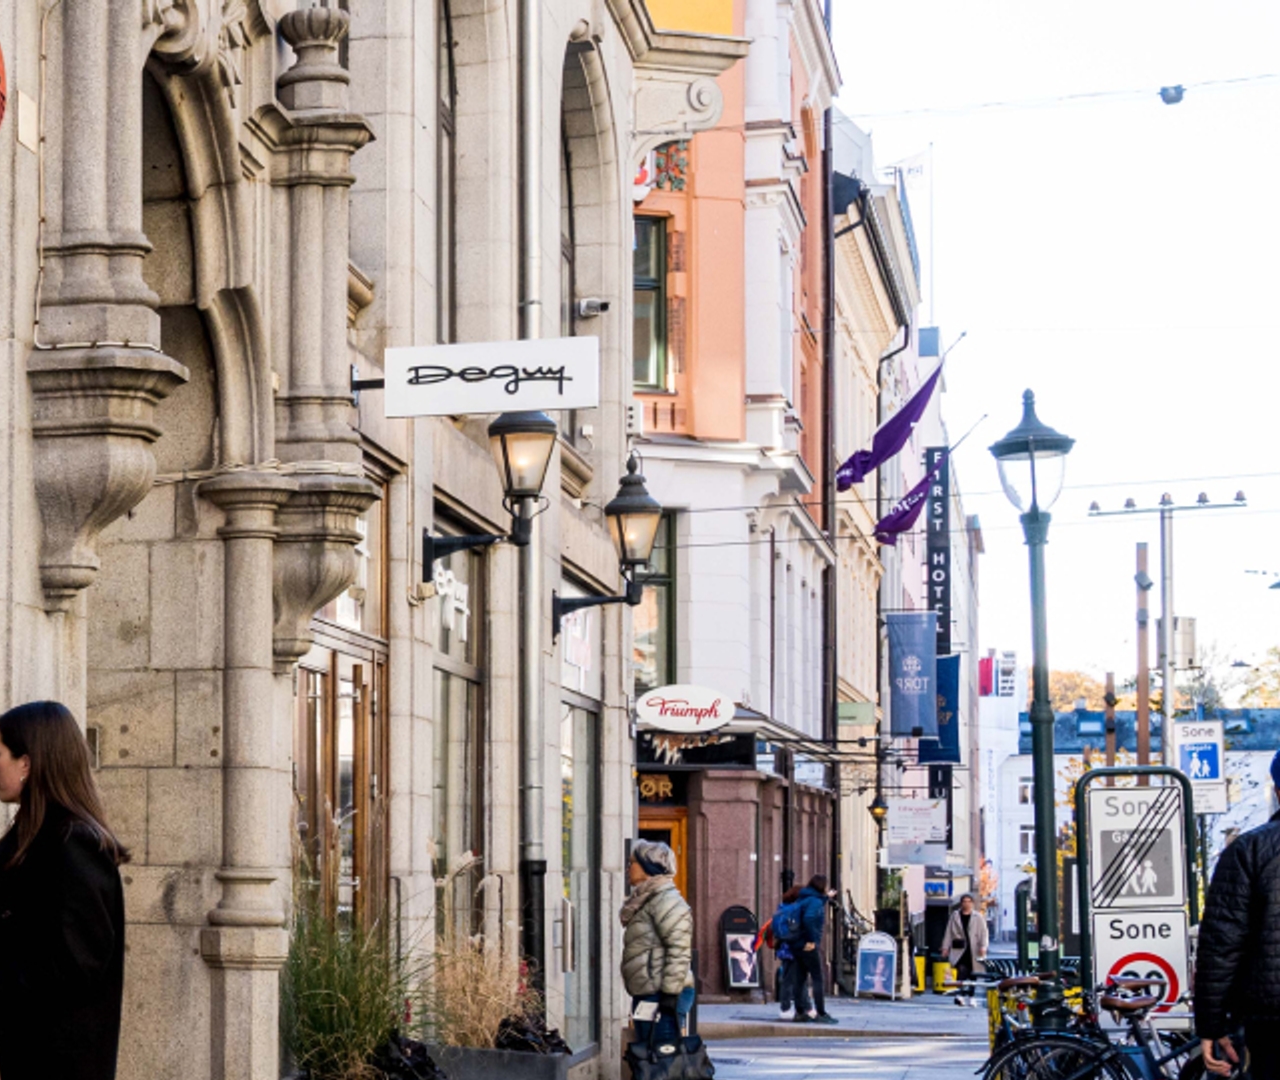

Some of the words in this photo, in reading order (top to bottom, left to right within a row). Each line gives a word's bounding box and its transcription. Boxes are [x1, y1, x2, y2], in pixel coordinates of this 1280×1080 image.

[646, 696, 721, 725] Triumph
[1181, 726, 1215, 738] Sone
[1109, 919, 1172, 939] Sone
